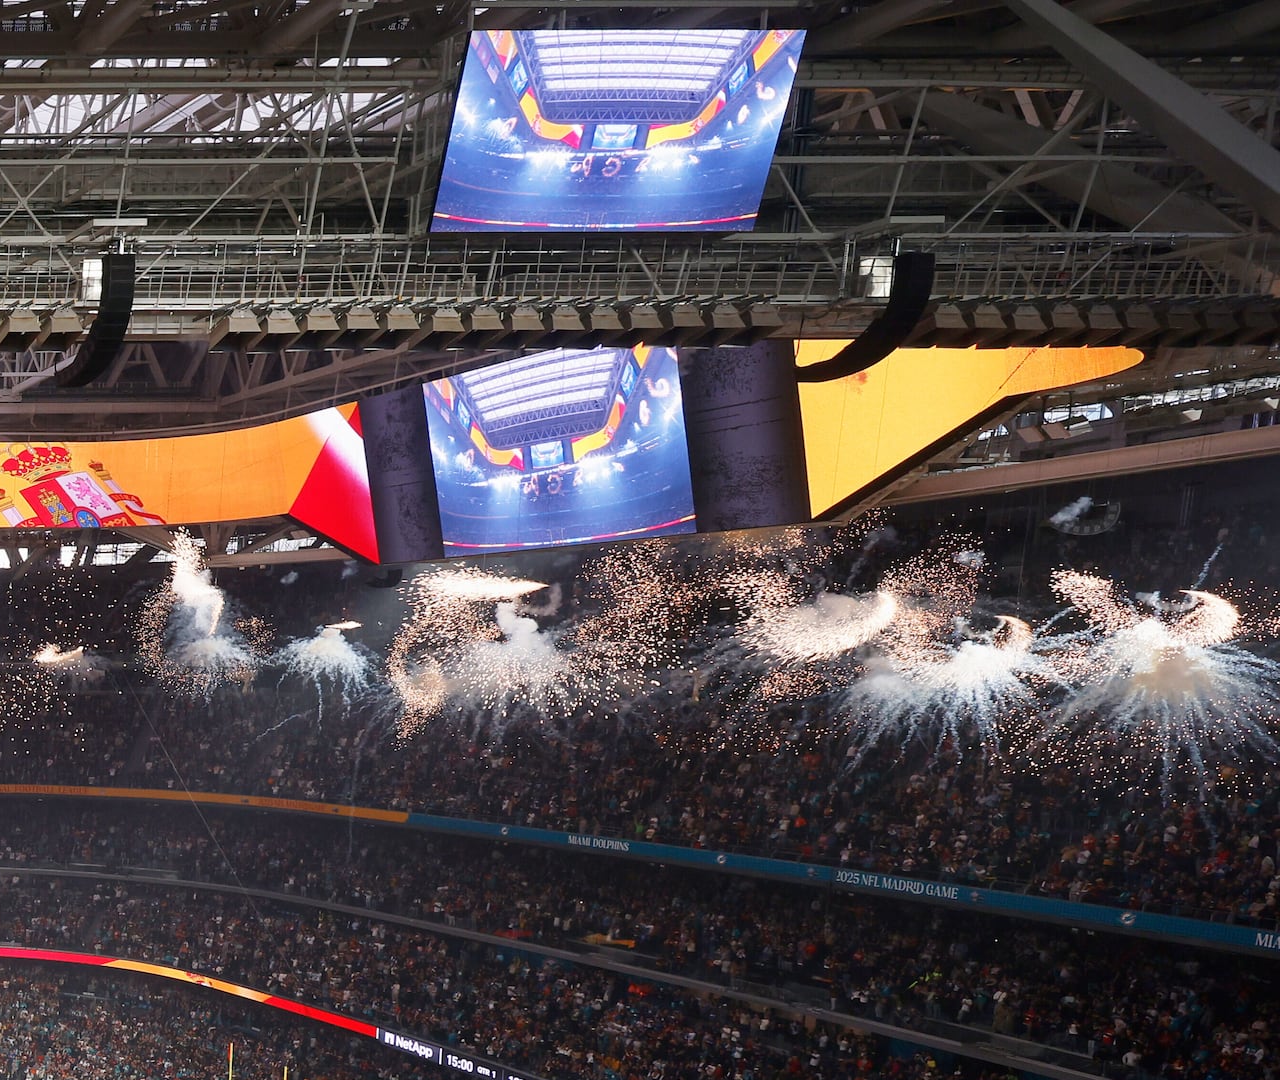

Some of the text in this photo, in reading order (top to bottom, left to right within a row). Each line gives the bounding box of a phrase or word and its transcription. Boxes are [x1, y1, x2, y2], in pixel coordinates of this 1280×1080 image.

[568, 835, 629, 852] MIAMI DOLPHINS
[836, 870, 959, 900] 2025 NFL MADRID GAME
[396, 1034, 433, 1059] NetApp
[446, 1054, 473, 1073] 15:00
[477, 1065, 490, 1077] QTR
